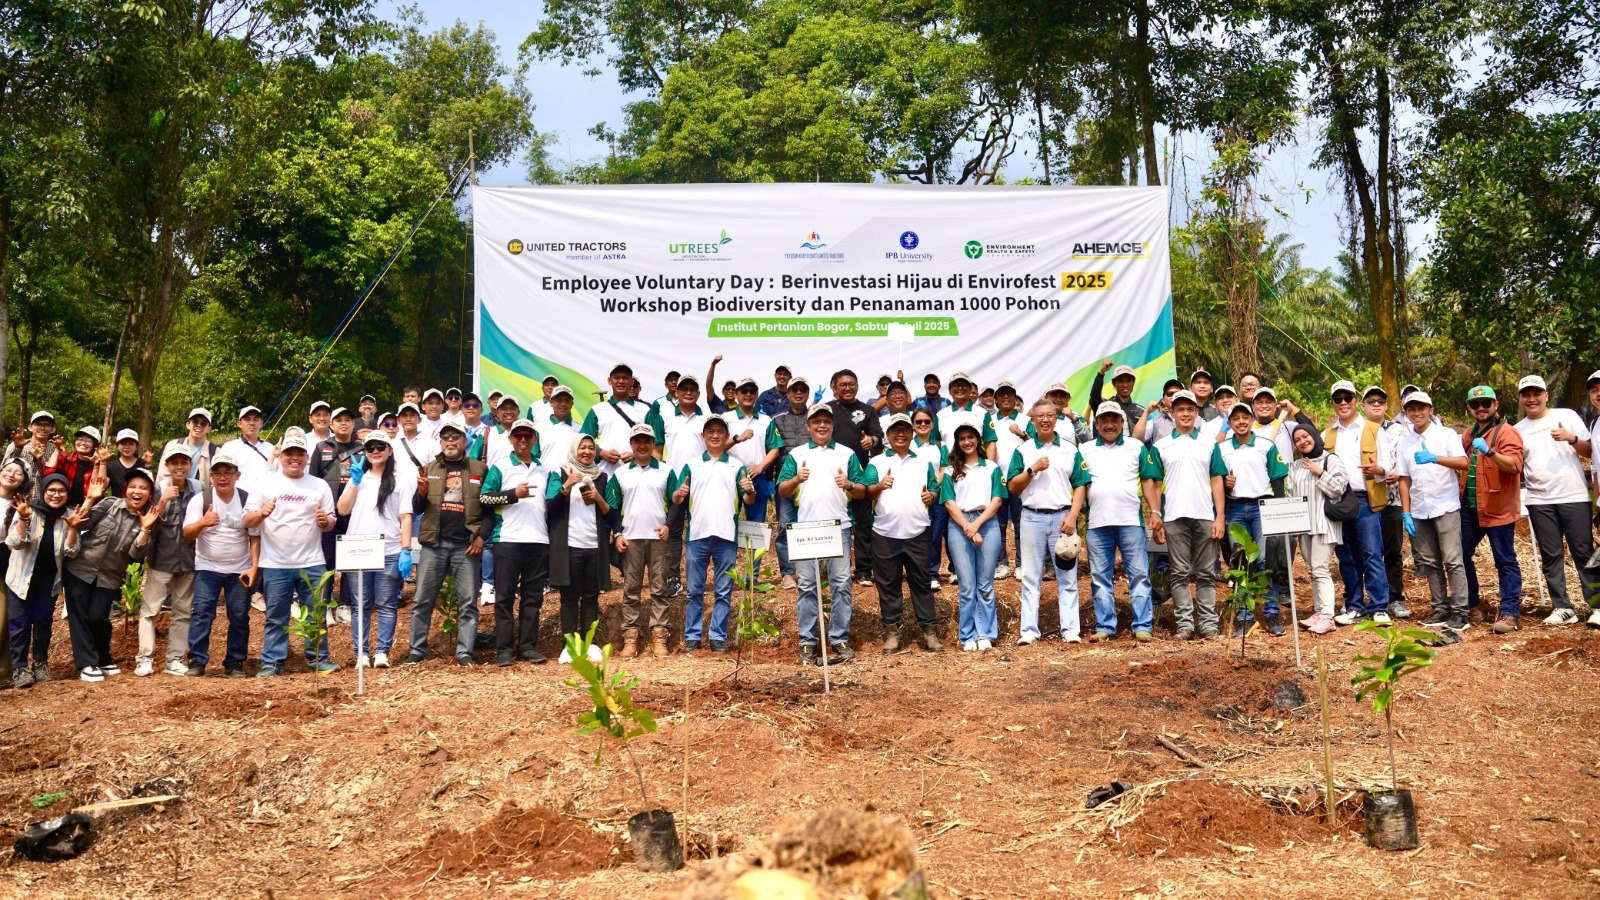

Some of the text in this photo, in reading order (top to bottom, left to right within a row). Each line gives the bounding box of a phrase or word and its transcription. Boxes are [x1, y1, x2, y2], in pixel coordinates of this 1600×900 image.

[526, 242, 627, 252] UNITED TRACTORS
[669, 243, 719, 254] UTREES
[1072, 242, 1142, 254] AHEMCE
[565, 253, 592, 261] member
[593, 253, 602, 261] of
[885, 252, 934, 262] IPB University
[541, 275, 632, 294] Employee
[634, 273, 726, 293] Voluntary
[730, 274, 765, 293] Day
[781, 273, 892, 290] Berinvestasi
[896, 272, 943, 293] Hijau
[946, 273, 963, 289] di
[967, 273, 1057, 290] Envirofest
[1067, 273, 1106, 290] 2025
[599, 295, 1061, 316] Workshop Biodiversity dan Penanaman 1000 Pohon
[716, 321, 756, 332] Institut
[758, 321, 815, 332] Pertanian
[816, 322, 853, 335] Bogor,
[855, 321, 888, 332] Sabtu
[924, 321, 950, 331] 2025
